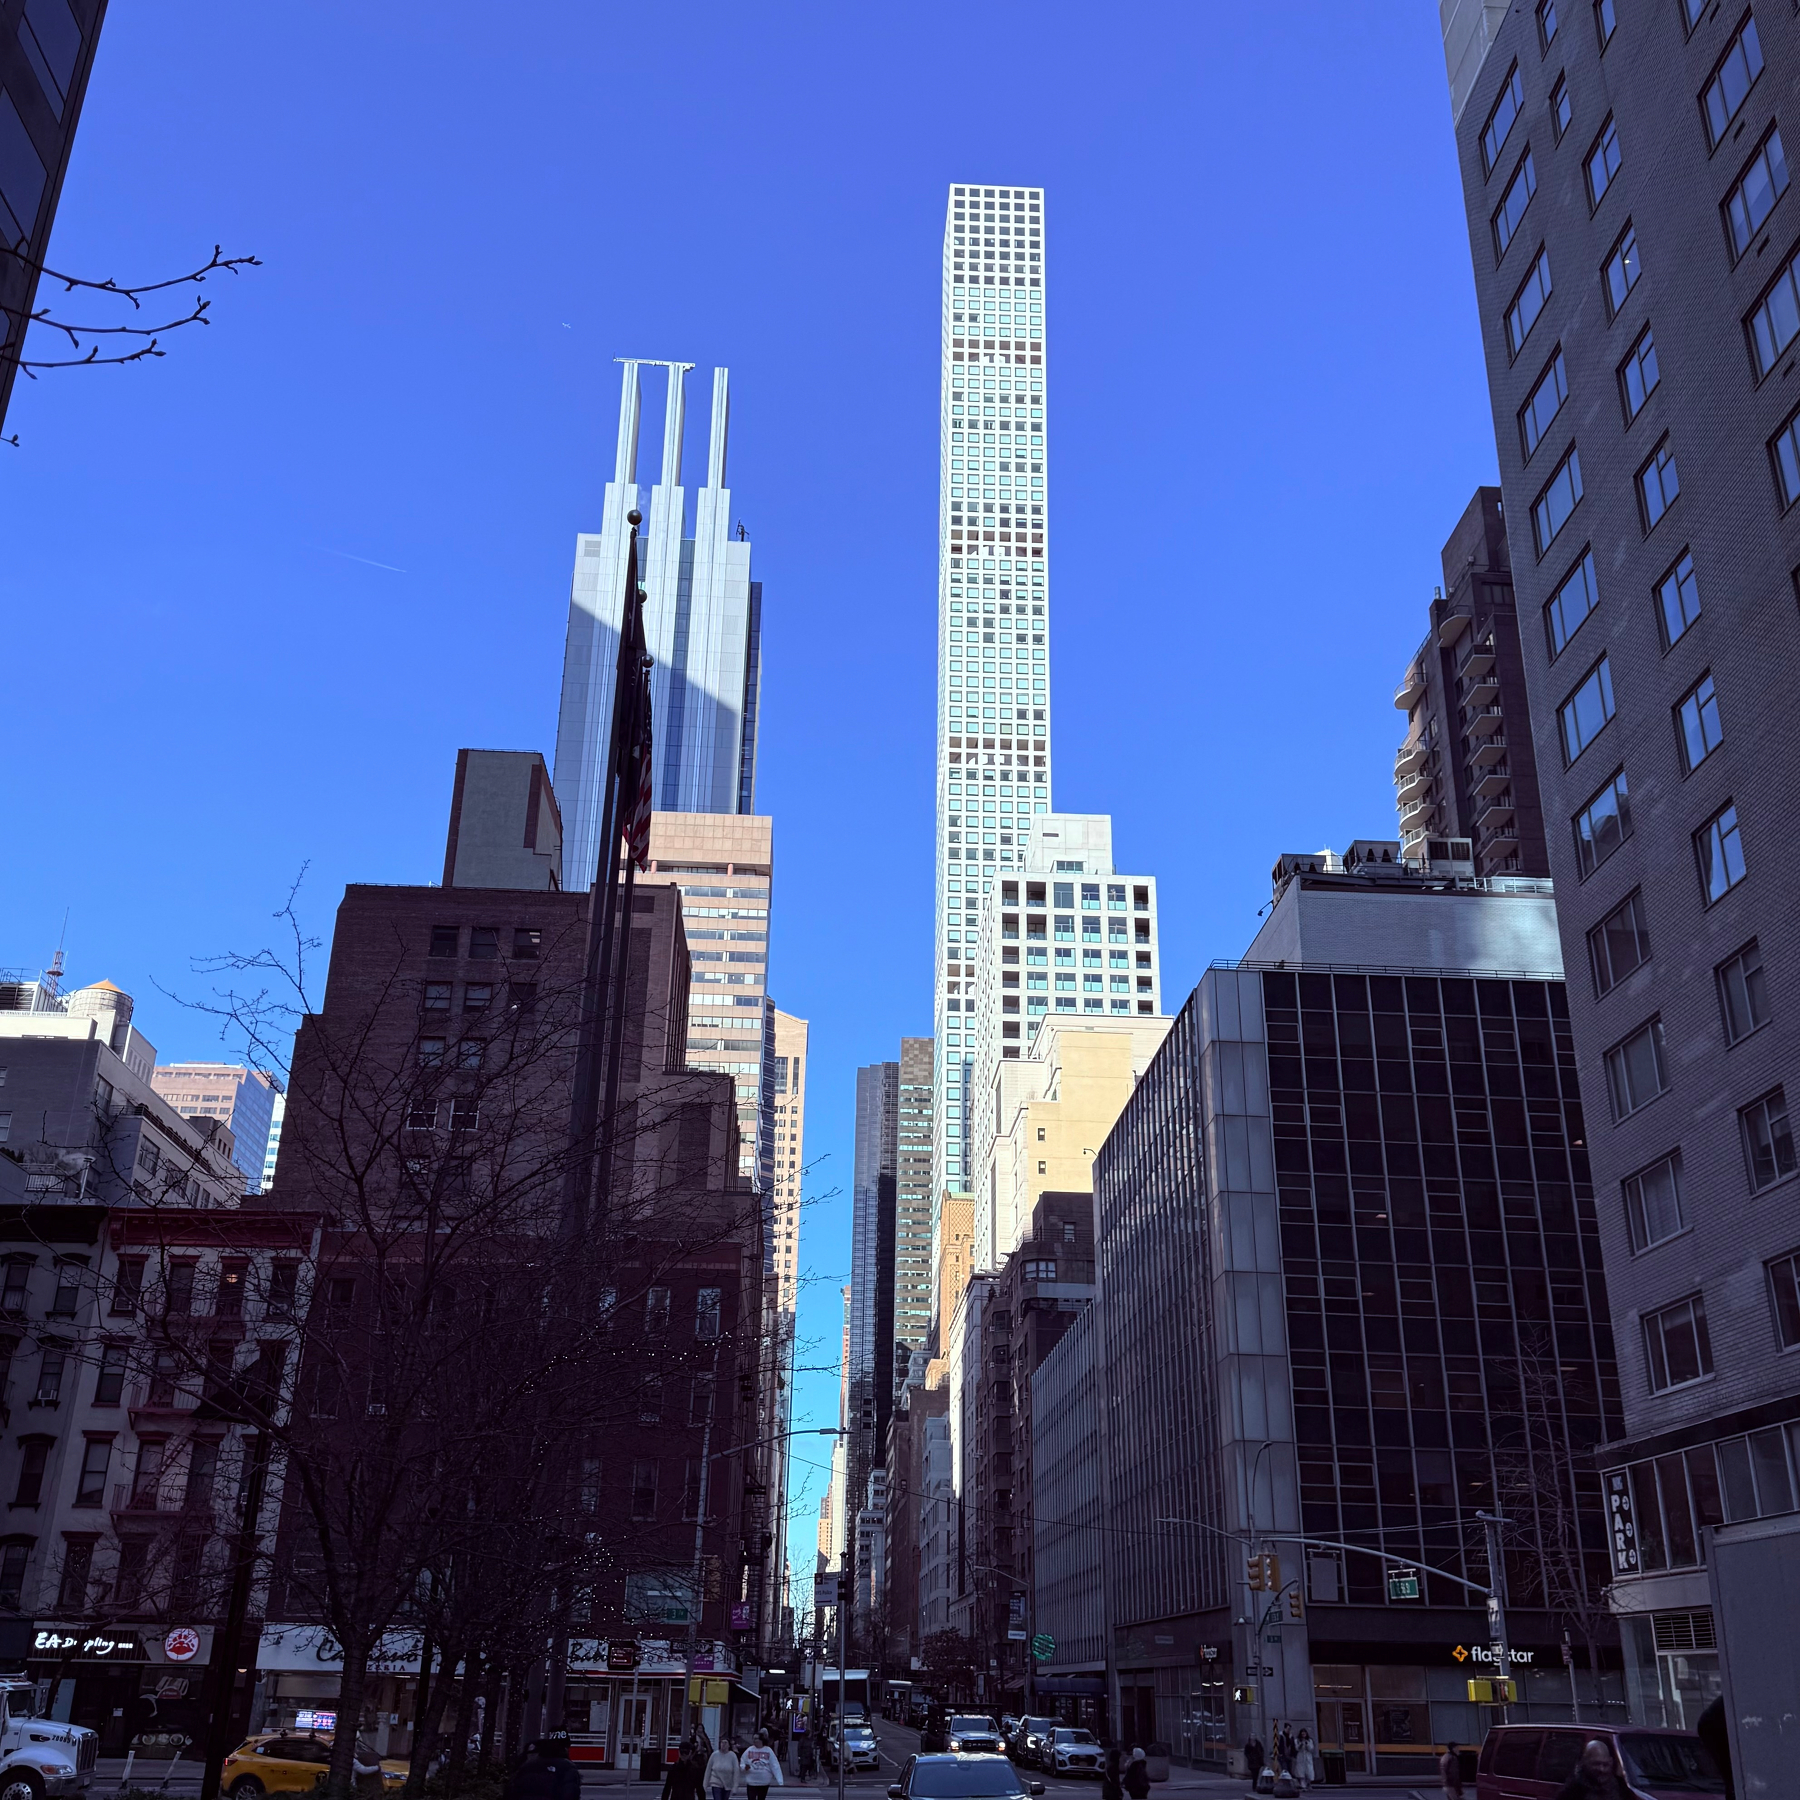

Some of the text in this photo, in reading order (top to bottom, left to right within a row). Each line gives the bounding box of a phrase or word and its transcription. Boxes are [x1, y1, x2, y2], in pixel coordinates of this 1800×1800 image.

[1611, 1494, 1629, 1569] PARK
[34, 1632, 115, 1655] EA Dpling
